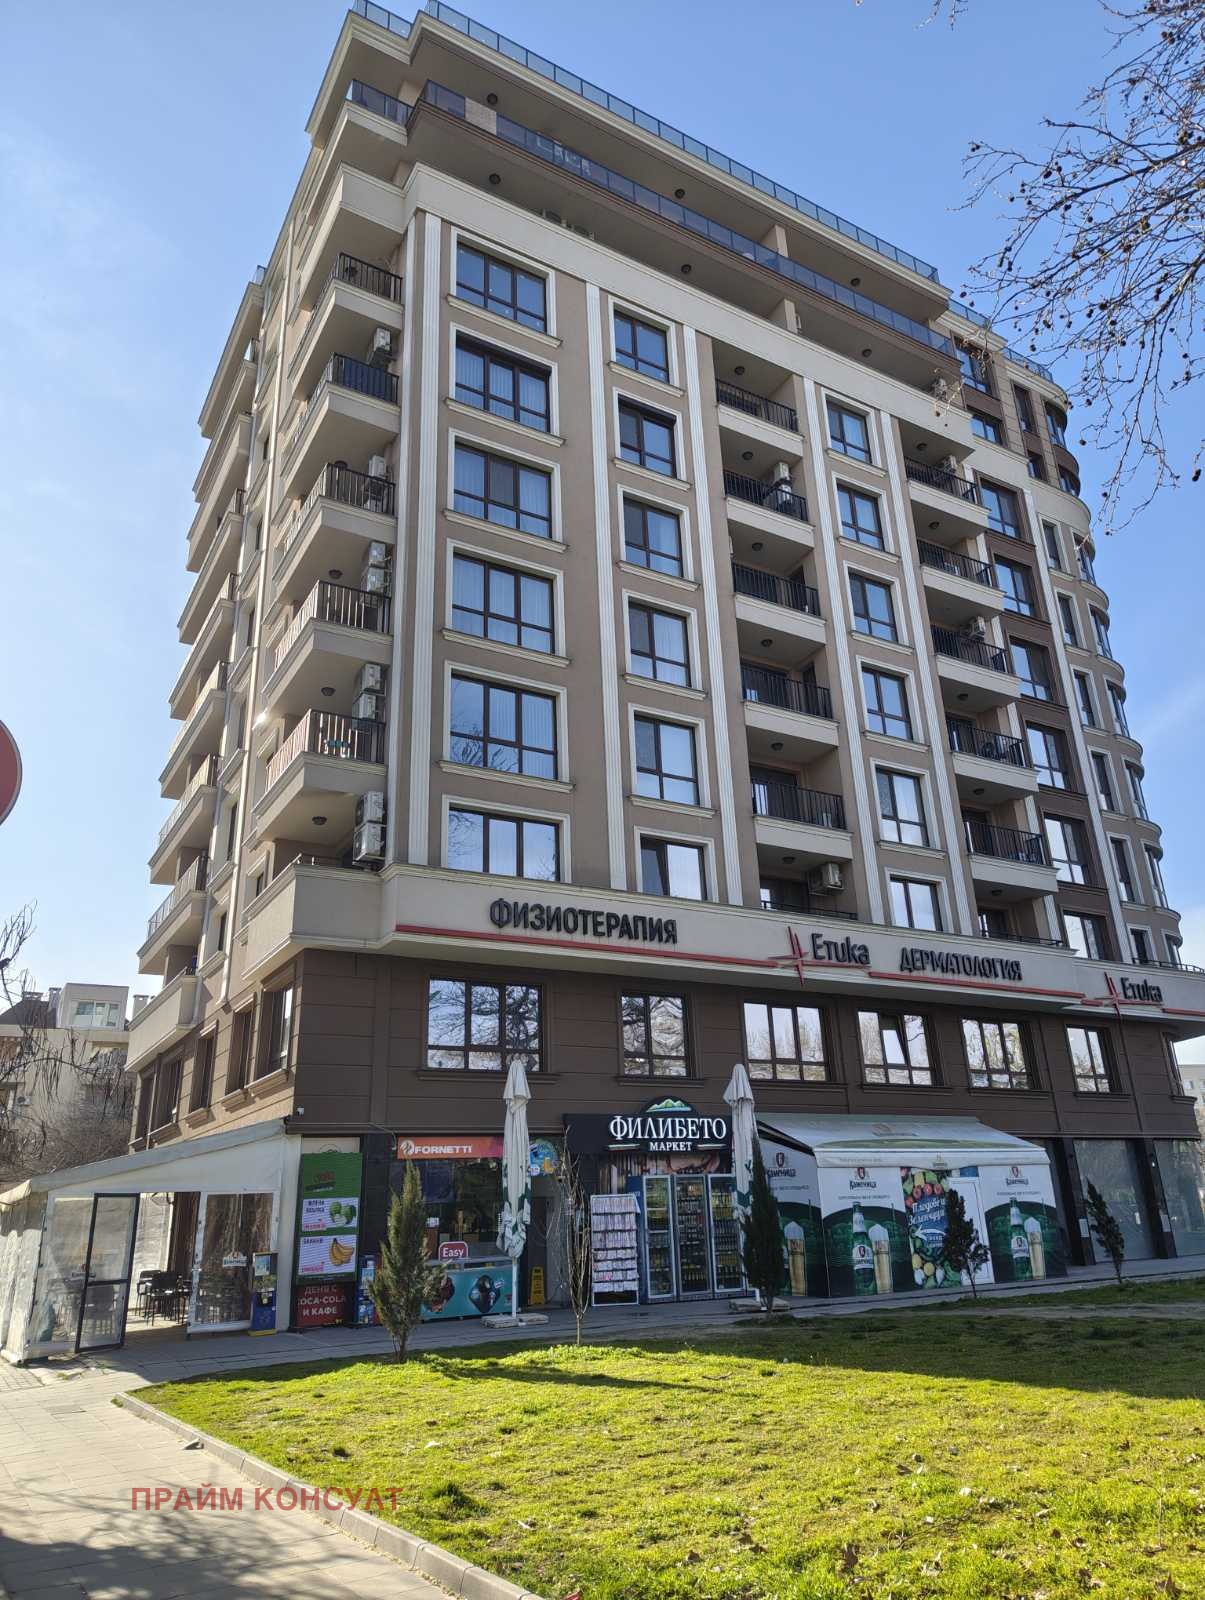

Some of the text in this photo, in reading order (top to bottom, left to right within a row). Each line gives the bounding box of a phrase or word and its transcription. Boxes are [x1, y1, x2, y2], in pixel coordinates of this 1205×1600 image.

[489, 898, 678, 944] ФИЗИОТЕРАПИЯ
[899, 947, 1023, 980] ДЕРМАТОЛОГИЯ
[609, 1115, 727, 1140] ФИЛИБЕТО
[415, 1145, 472, 1154] FORNETTI
[649, 1141, 693, 1151] МАРКЕТ
[442, 1247, 465, 1259] Easy
